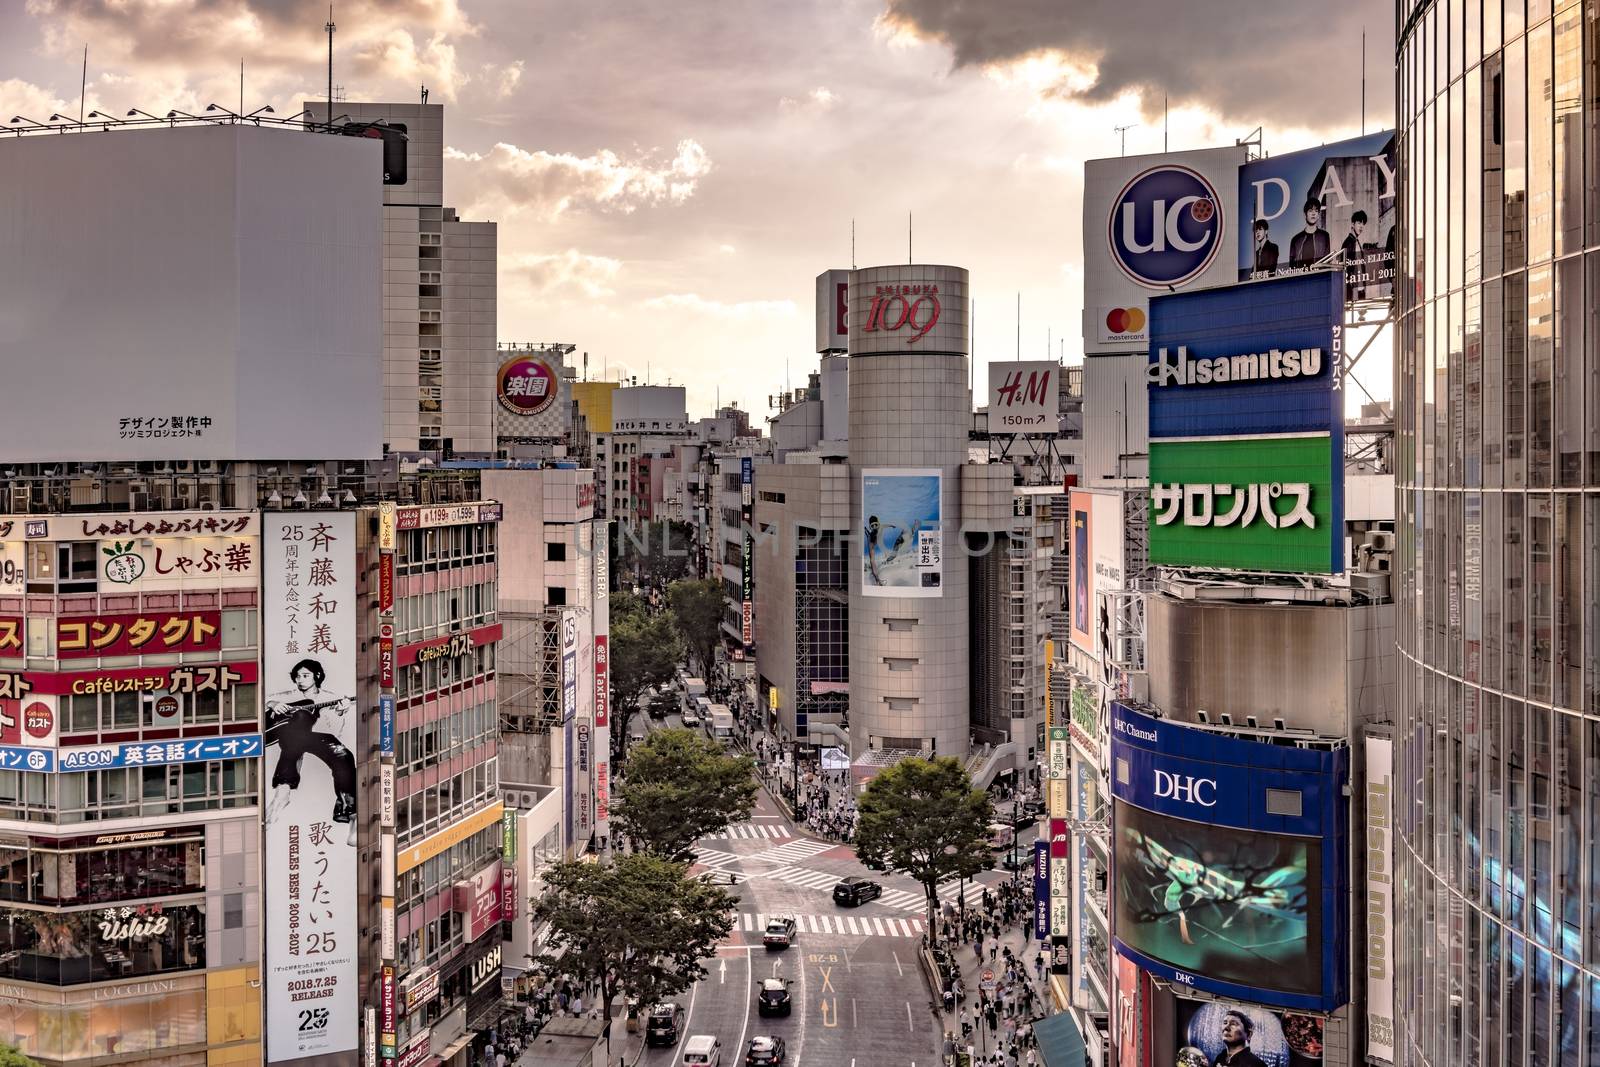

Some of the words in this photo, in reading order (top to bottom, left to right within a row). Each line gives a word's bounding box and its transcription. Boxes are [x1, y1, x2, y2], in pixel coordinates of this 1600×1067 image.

[1251, 154, 1396, 222] DAY
[1367, 252, 1396, 262] ELLEG
[876, 284, 939, 295] SHIBUYA
[864, 294, 941, 343] 109
[1107, 333, 1145, 341] mastercard
[1146, 346, 1321, 387] Hisamitsu
[1332, 325, 1342, 391] サロンパス
[506, 376, 549, 396] 楽園
[997, 370, 1050, 407] H&M
[119, 416, 212, 429] デザイン製作中
[639, 421, 686, 430] 井門ビル
[1002, 415, 1033, 425] 150m
[1151, 482, 1315, 529] サロンパス
[27, 525, 45, 536] 寿司
[82, 516, 250, 536] しゃぶしゃぶバイキング
[155, 543, 251, 575] しゃぶ葉
[307, 522, 338, 654] 斉藤和義
[597, 550, 606, 599] CAMERA
[281, 525, 304, 654] 25周年記念ベスト盤
[59, 615, 218, 649] コンタクト
[743, 603, 751, 642] HOOTERS
[382, 651, 391, 681] ガスト
[169, 667, 242, 694] ガスト
[596, 671, 606, 718] TaxFree
[28, 718, 50, 728] ガスト
[1126, 724, 1157, 742] Channel
[30, 754, 43, 767] 6F
[66, 751, 113, 767] AEON
[125, 739, 258, 765] 英会話イーオン
[1153, 769, 1217, 807] DHC
[289, 825, 299, 871] SINGLES
[1039, 849, 1047, 879] MIZUHO
[289, 873, 299, 899] BEST
[103, 907, 130, 920] 渋谷
[98, 916, 168, 941] Ushi8
[289, 903, 299, 956] 2008-2017
[1368, 890, 1386, 981] neon
[471, 946, 501, 986] LUSH
[1175, 972, 1194, 985] DHC
[94, 980, 177, 1000] L'OCCITANE
[287, 975, 337, 992] 2018.7.25
[291, 989, 334, 1002] RELEASE
